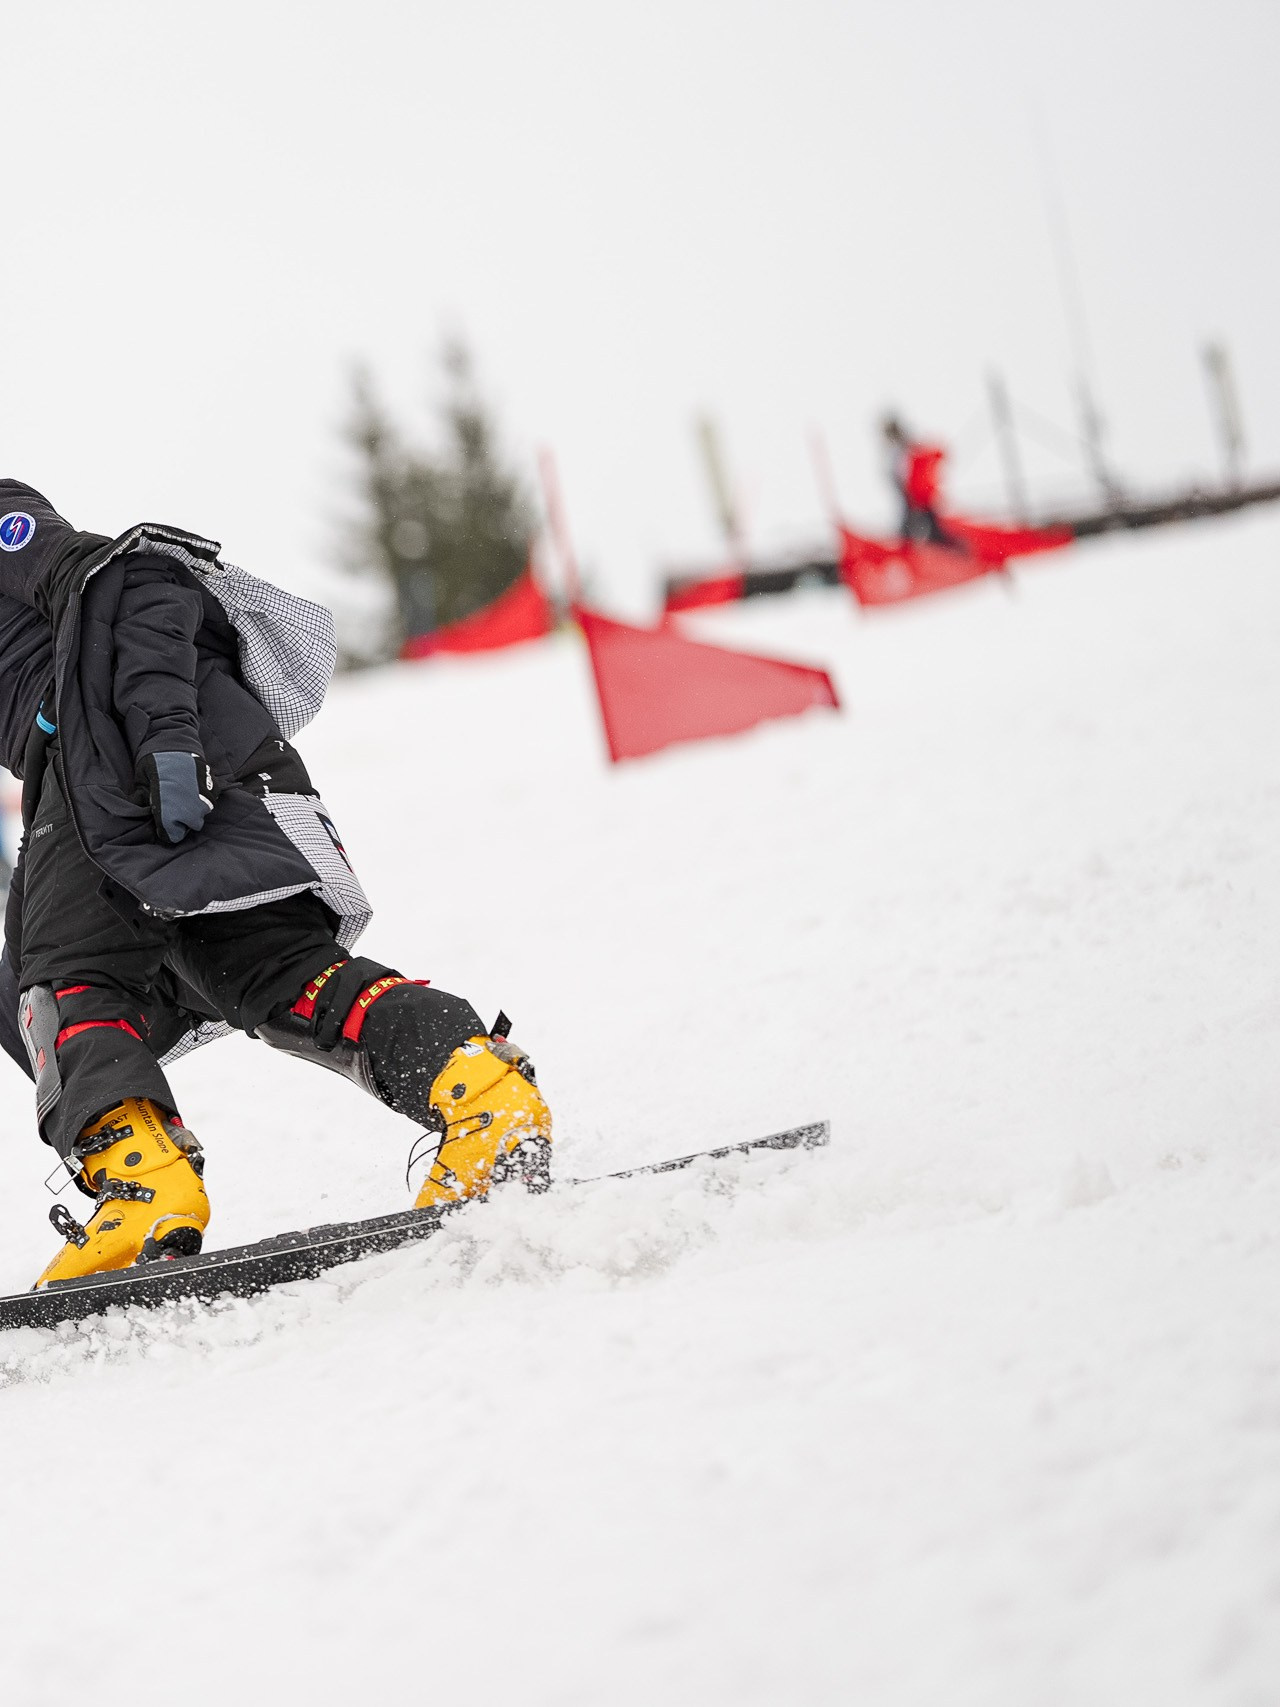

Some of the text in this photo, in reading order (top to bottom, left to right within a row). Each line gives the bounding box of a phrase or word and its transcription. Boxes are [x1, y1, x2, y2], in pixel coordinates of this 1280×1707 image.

[306, 962, 344, 1001] LEKI
[359, 977, 404, 1009] LEKI
[135, 1099, 169, 1154] ountain Slope
